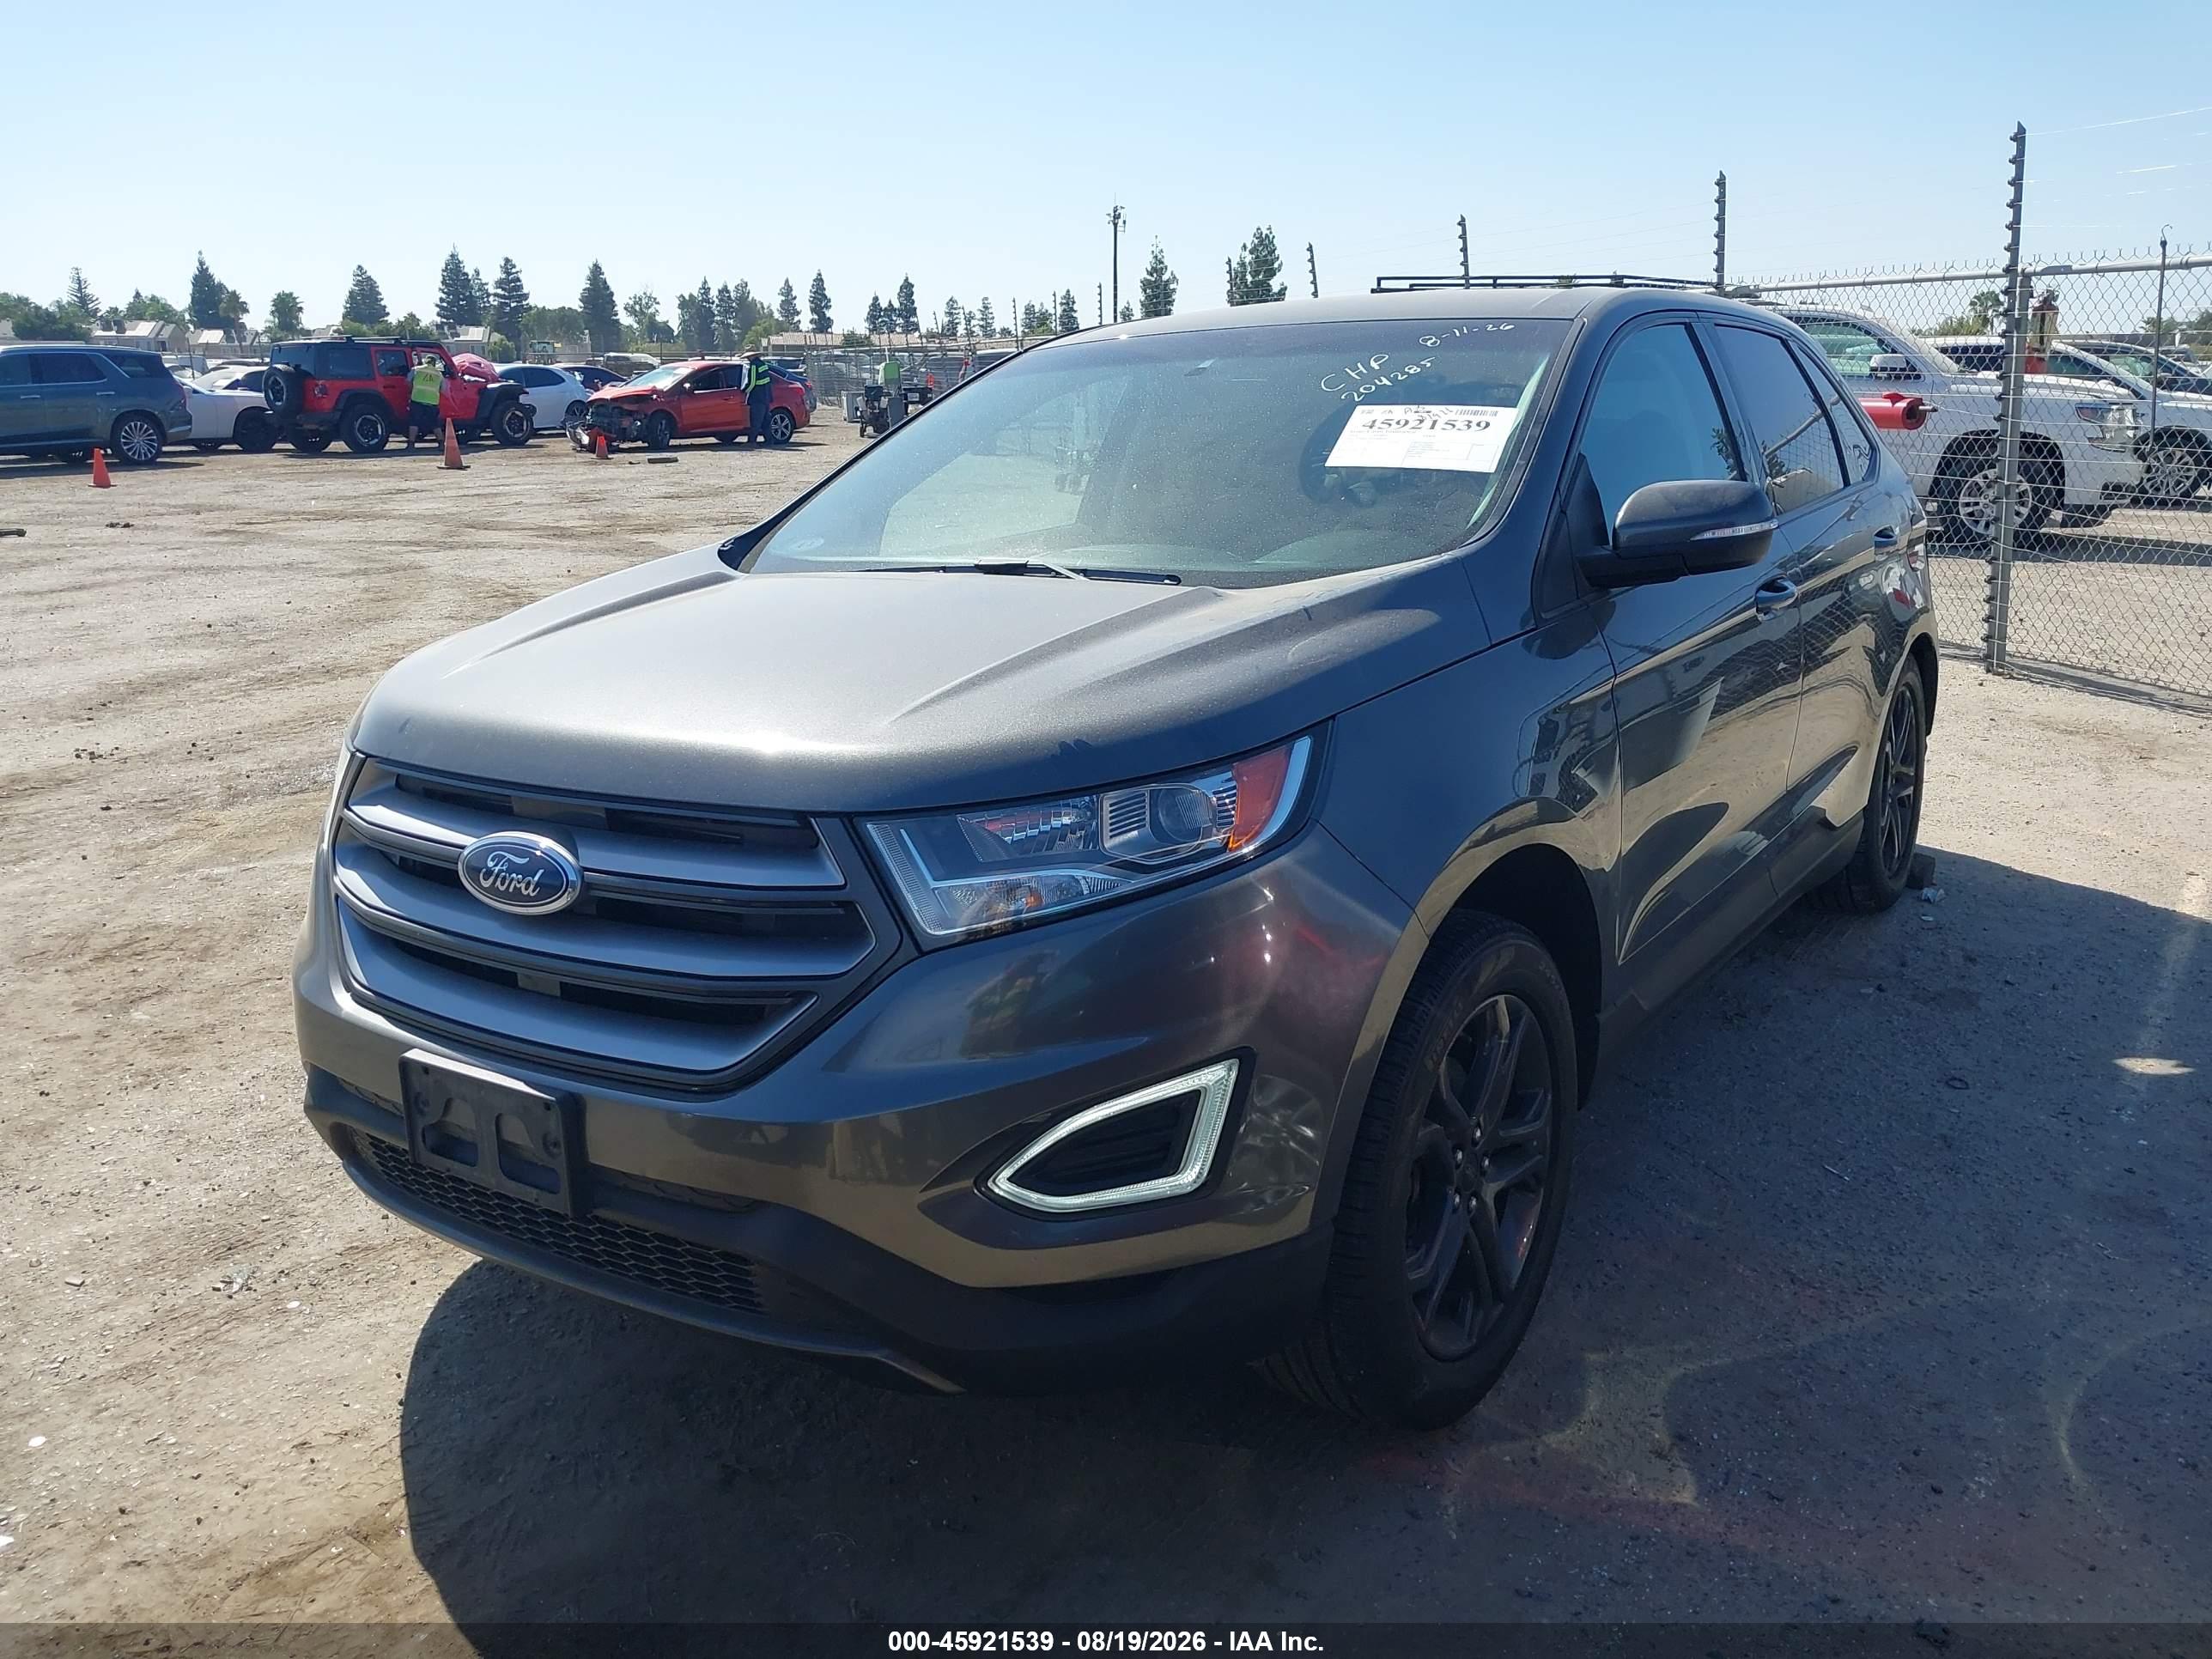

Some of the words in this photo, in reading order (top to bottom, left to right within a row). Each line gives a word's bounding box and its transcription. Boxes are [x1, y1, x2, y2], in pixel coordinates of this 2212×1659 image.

[1419, 322, 1515, 347] 8-11-26
[1320, 353, 1389, 392] CHP
[1340, 356, 1436, 402] 204285
[1362, 417, 1491, 432] 45921539
[478, 850, 545, 897] Ford
